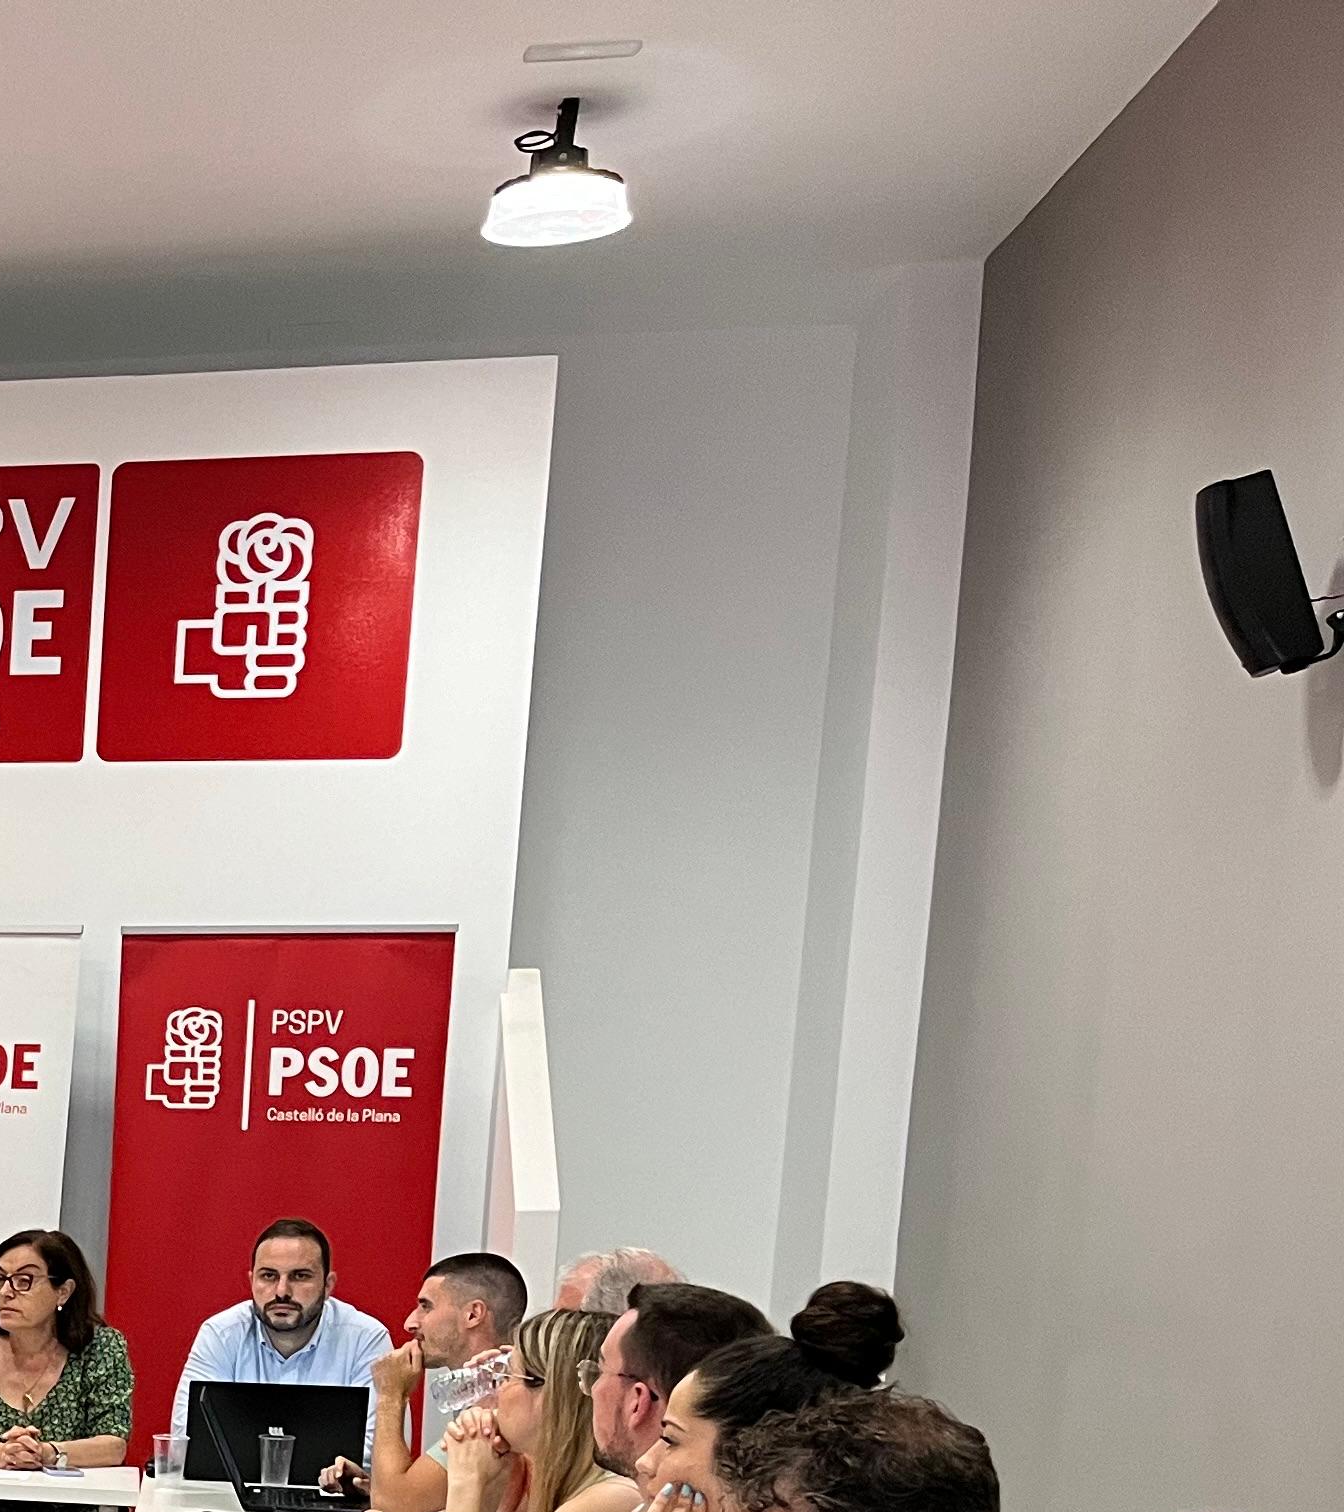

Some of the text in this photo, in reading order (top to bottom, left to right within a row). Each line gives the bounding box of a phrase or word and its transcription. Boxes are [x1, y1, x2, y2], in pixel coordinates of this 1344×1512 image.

[271, 1009, 344, 1035] PSPV
[268, 1046, 415, 1098] PSOE
[266, 1107, 401, 1123] Castelló de la Plana
